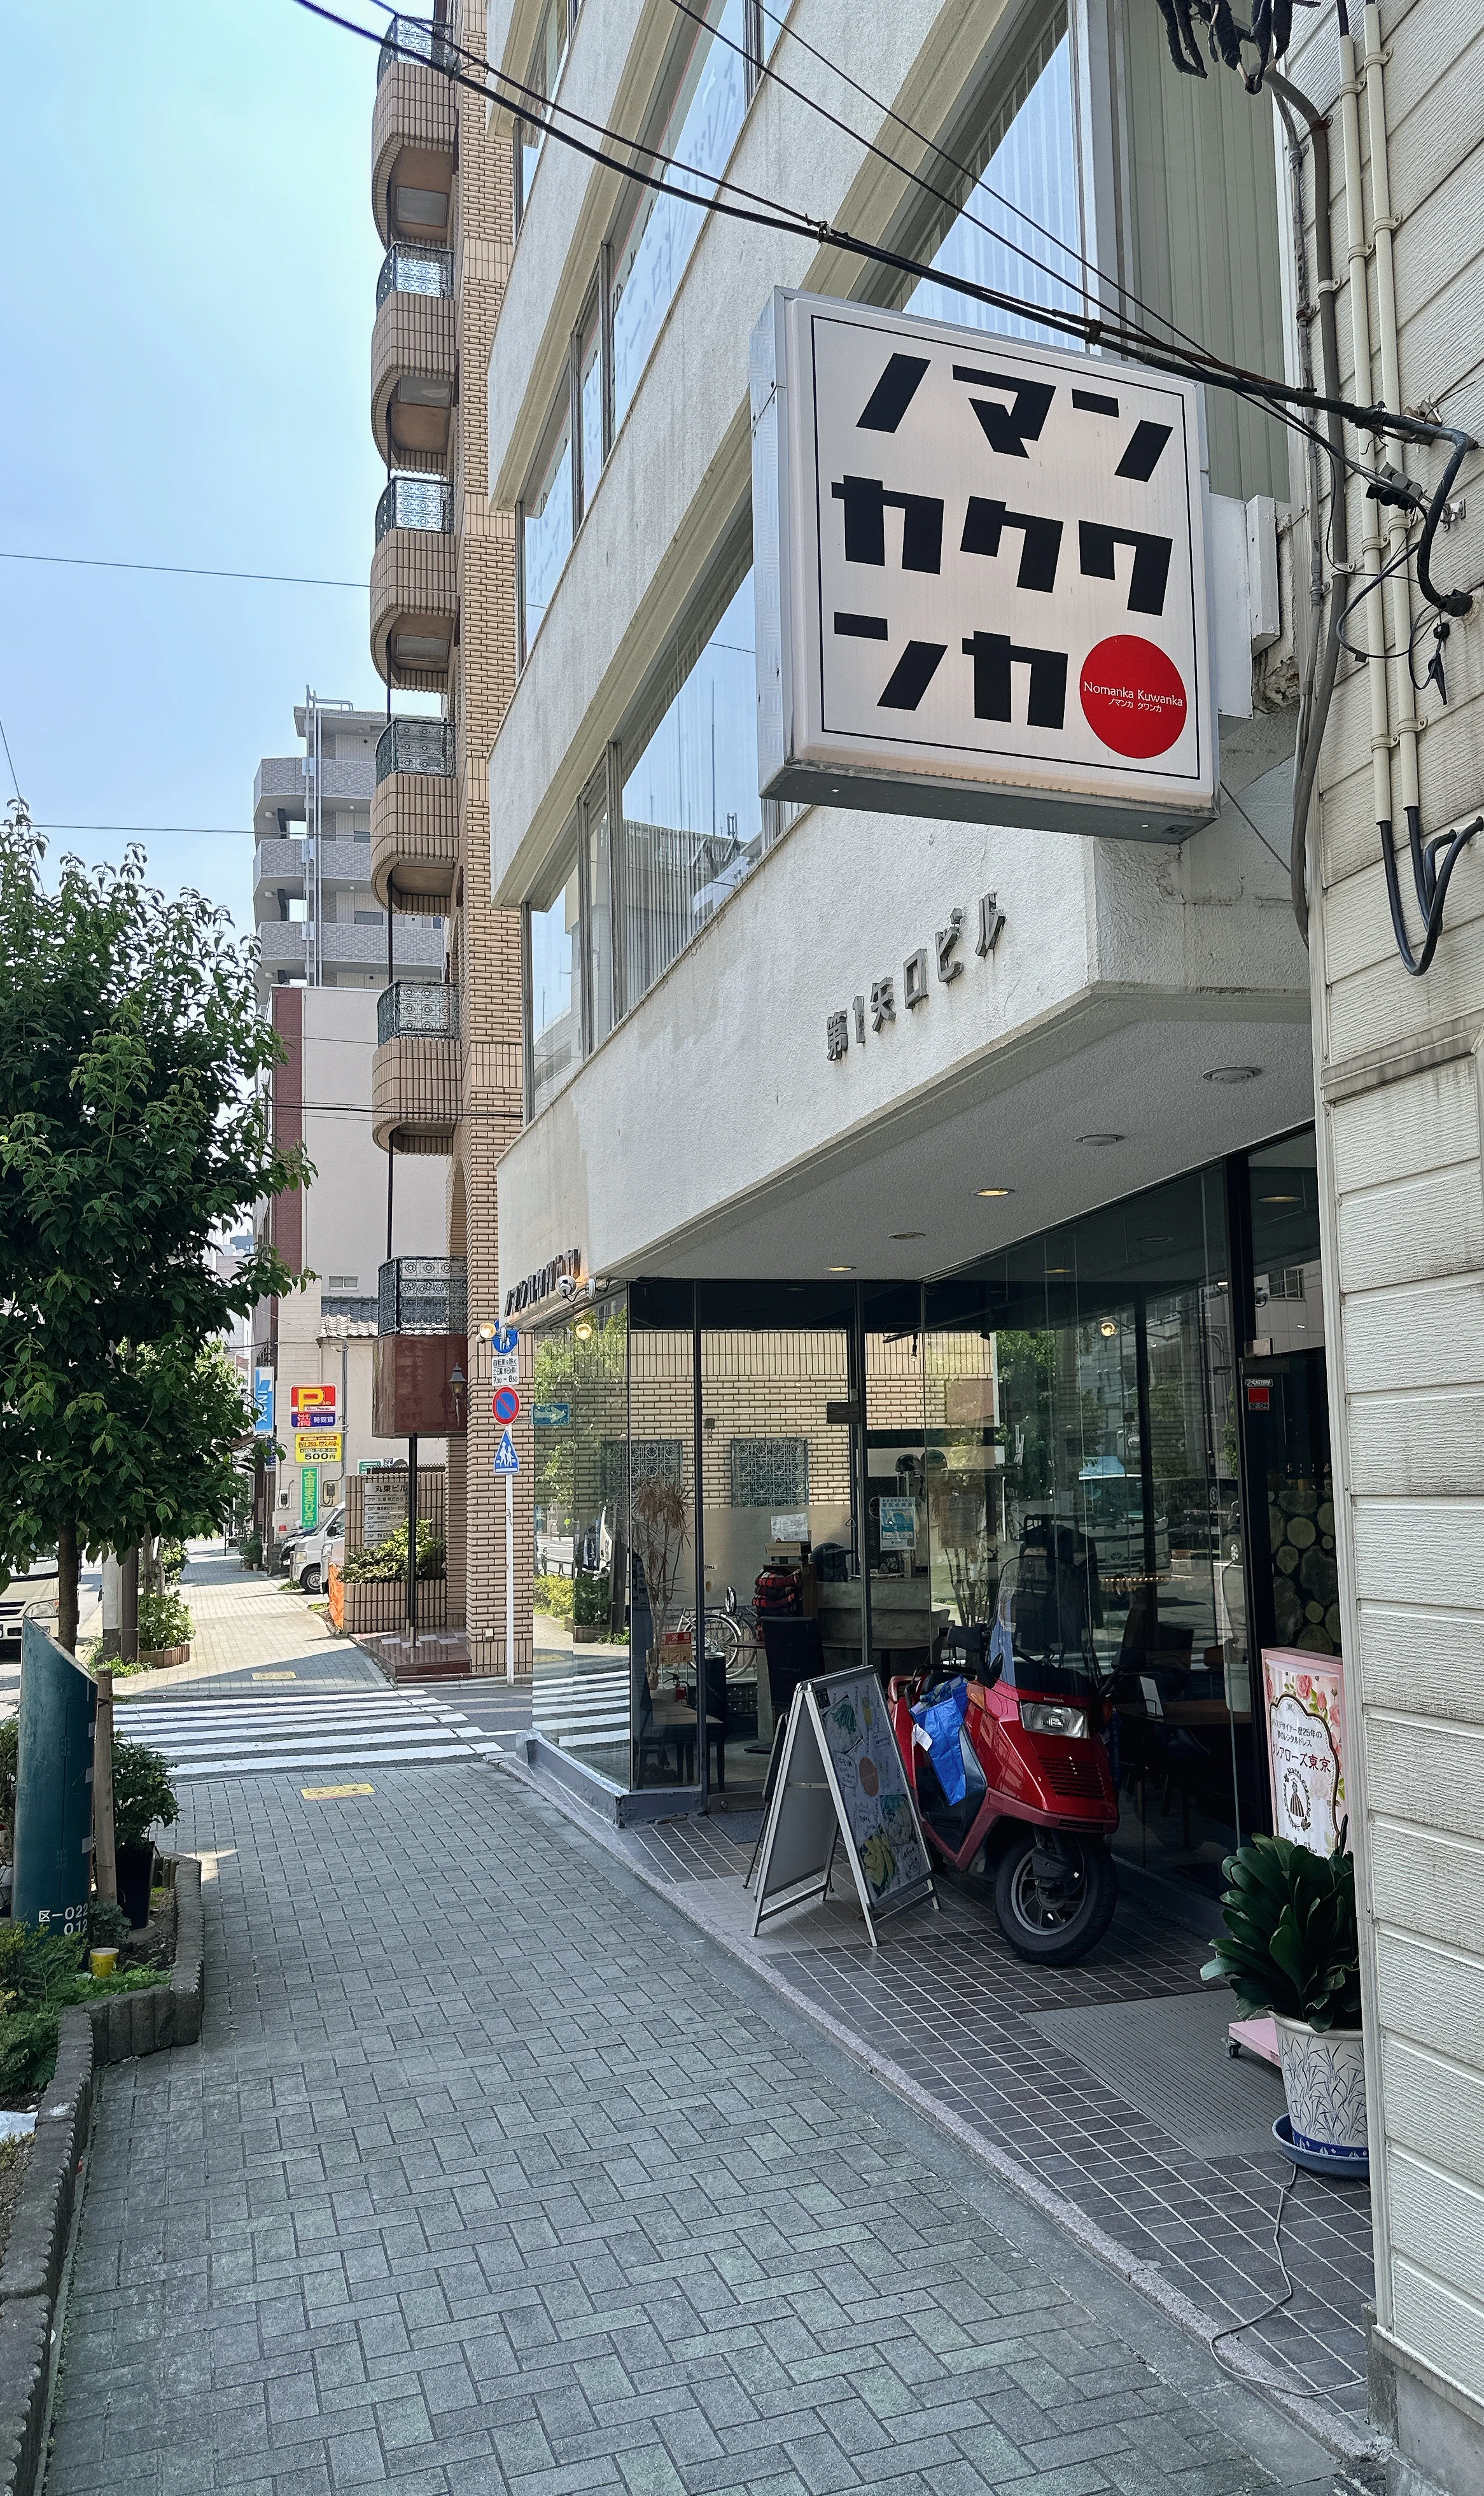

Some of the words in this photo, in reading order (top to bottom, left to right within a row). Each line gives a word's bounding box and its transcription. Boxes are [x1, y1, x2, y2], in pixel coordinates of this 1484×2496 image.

[856, 353, 1173, 482] ノマン
[832, 475, 1173, 616] カクワ
[834, 612, 1068, 730] ンカ
[1084, 681, 1134, 699] Nomanka
[1137, 689, 1183, 706] Kuwanka
[1109, 698, 1133, 708] ノマンカ
[1137, 702, 1162, 713] クワンカ
[298, 1388, 325, 1412] P
[375, 1485, 407, 1493] 丸東ビル
[1273, 1742, 1331, 1773] クレアローズ東京
